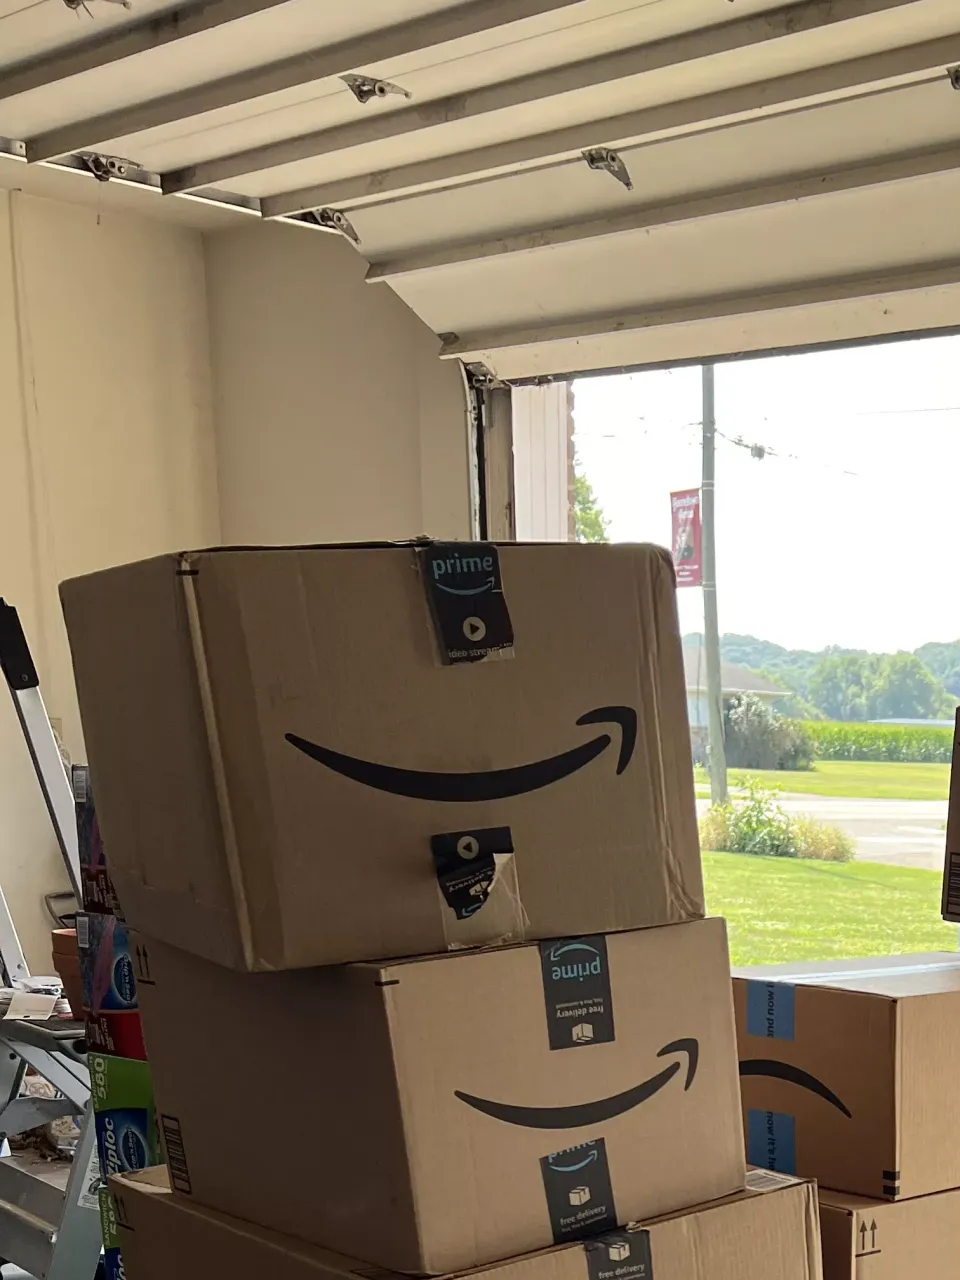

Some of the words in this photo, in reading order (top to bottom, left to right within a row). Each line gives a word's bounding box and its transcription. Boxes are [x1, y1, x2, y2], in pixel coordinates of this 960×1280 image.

[432, 553, 493, 580] prime
[551, 956, 601, 982] prime
[556, 1006, 587, 1018] delivery
[588, 1004, 605, 1015] free
[94, 1057, 106, 1099] 580
[100, 1193, 111, 1246] SANDWICH
[576, 1205, 607, 1219] delivery
[615, 1263, 645, 1276] delivery
